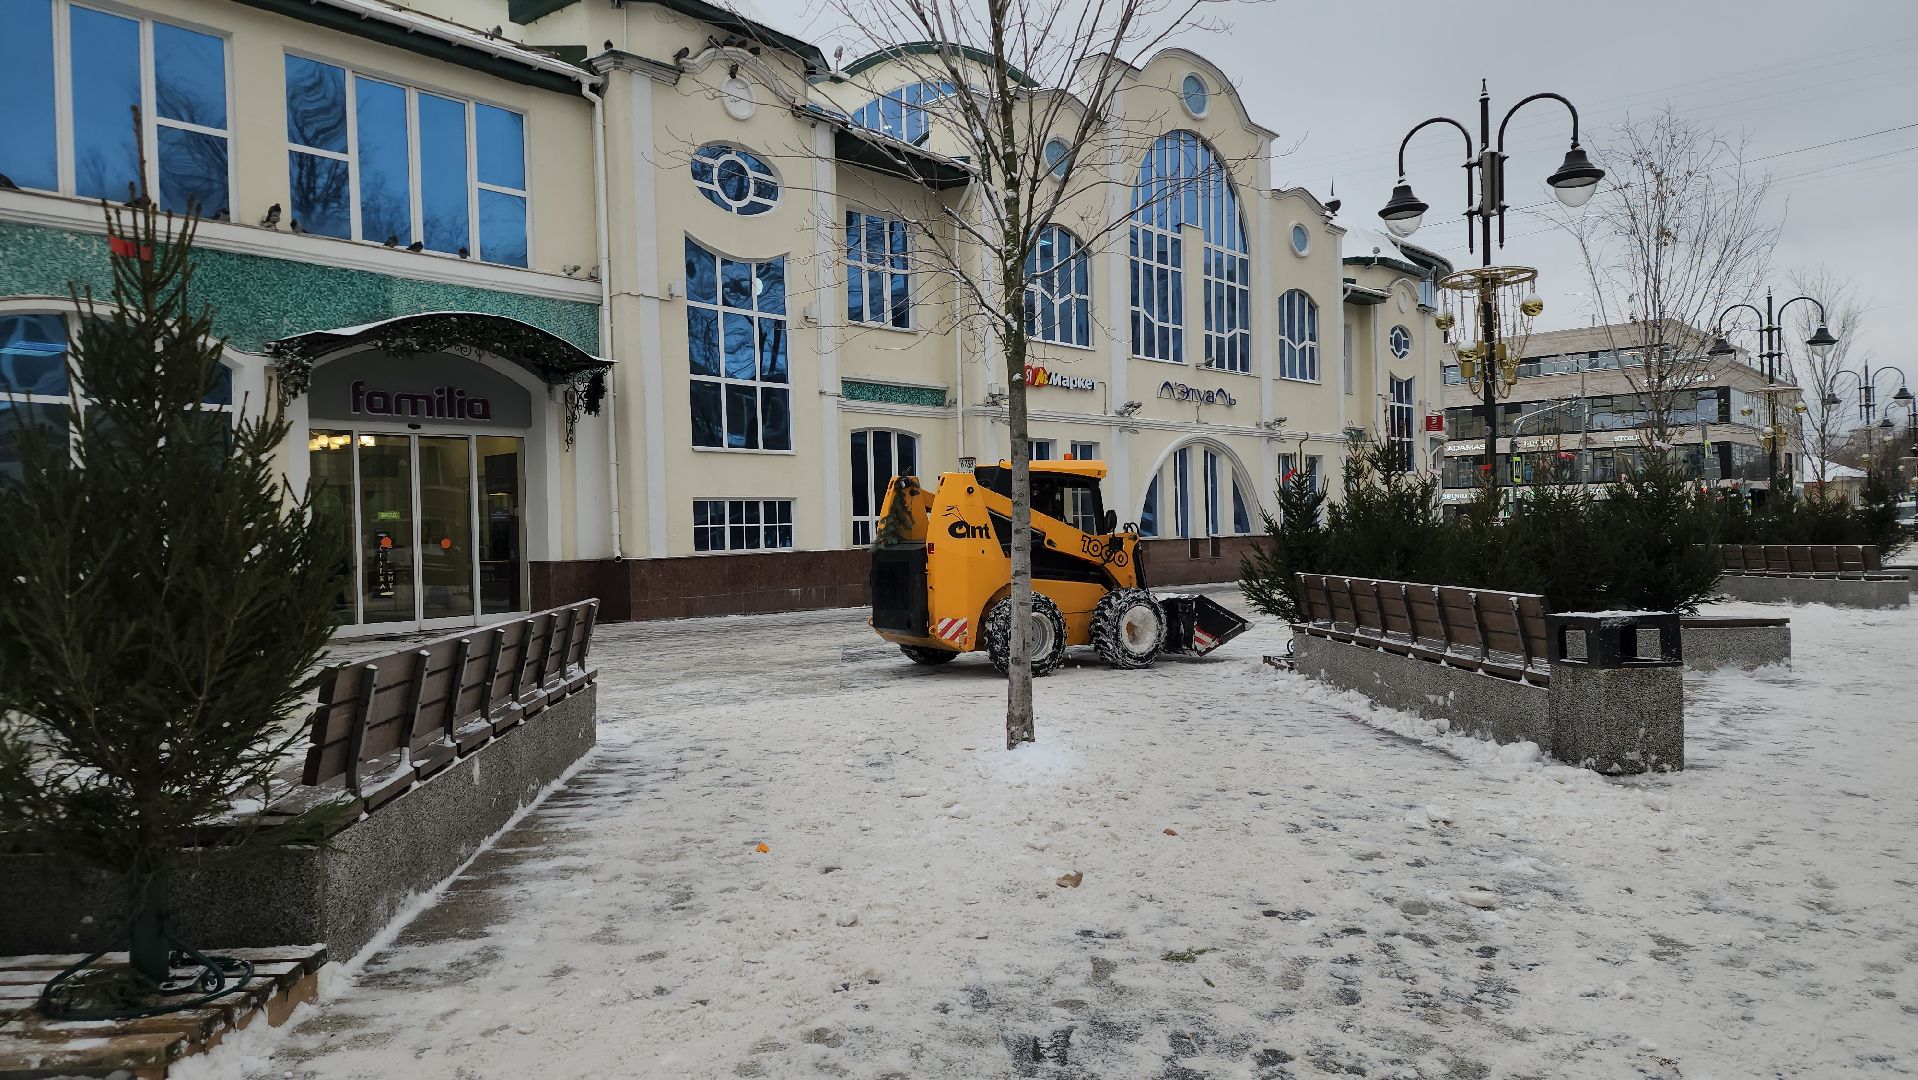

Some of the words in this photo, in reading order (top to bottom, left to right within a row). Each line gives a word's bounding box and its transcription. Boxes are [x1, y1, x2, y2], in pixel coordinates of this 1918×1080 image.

[1049, 371, 1097, 391] Маркет
[351, 380, 491, 421] familia
[947, 520, 991, 539] ant
